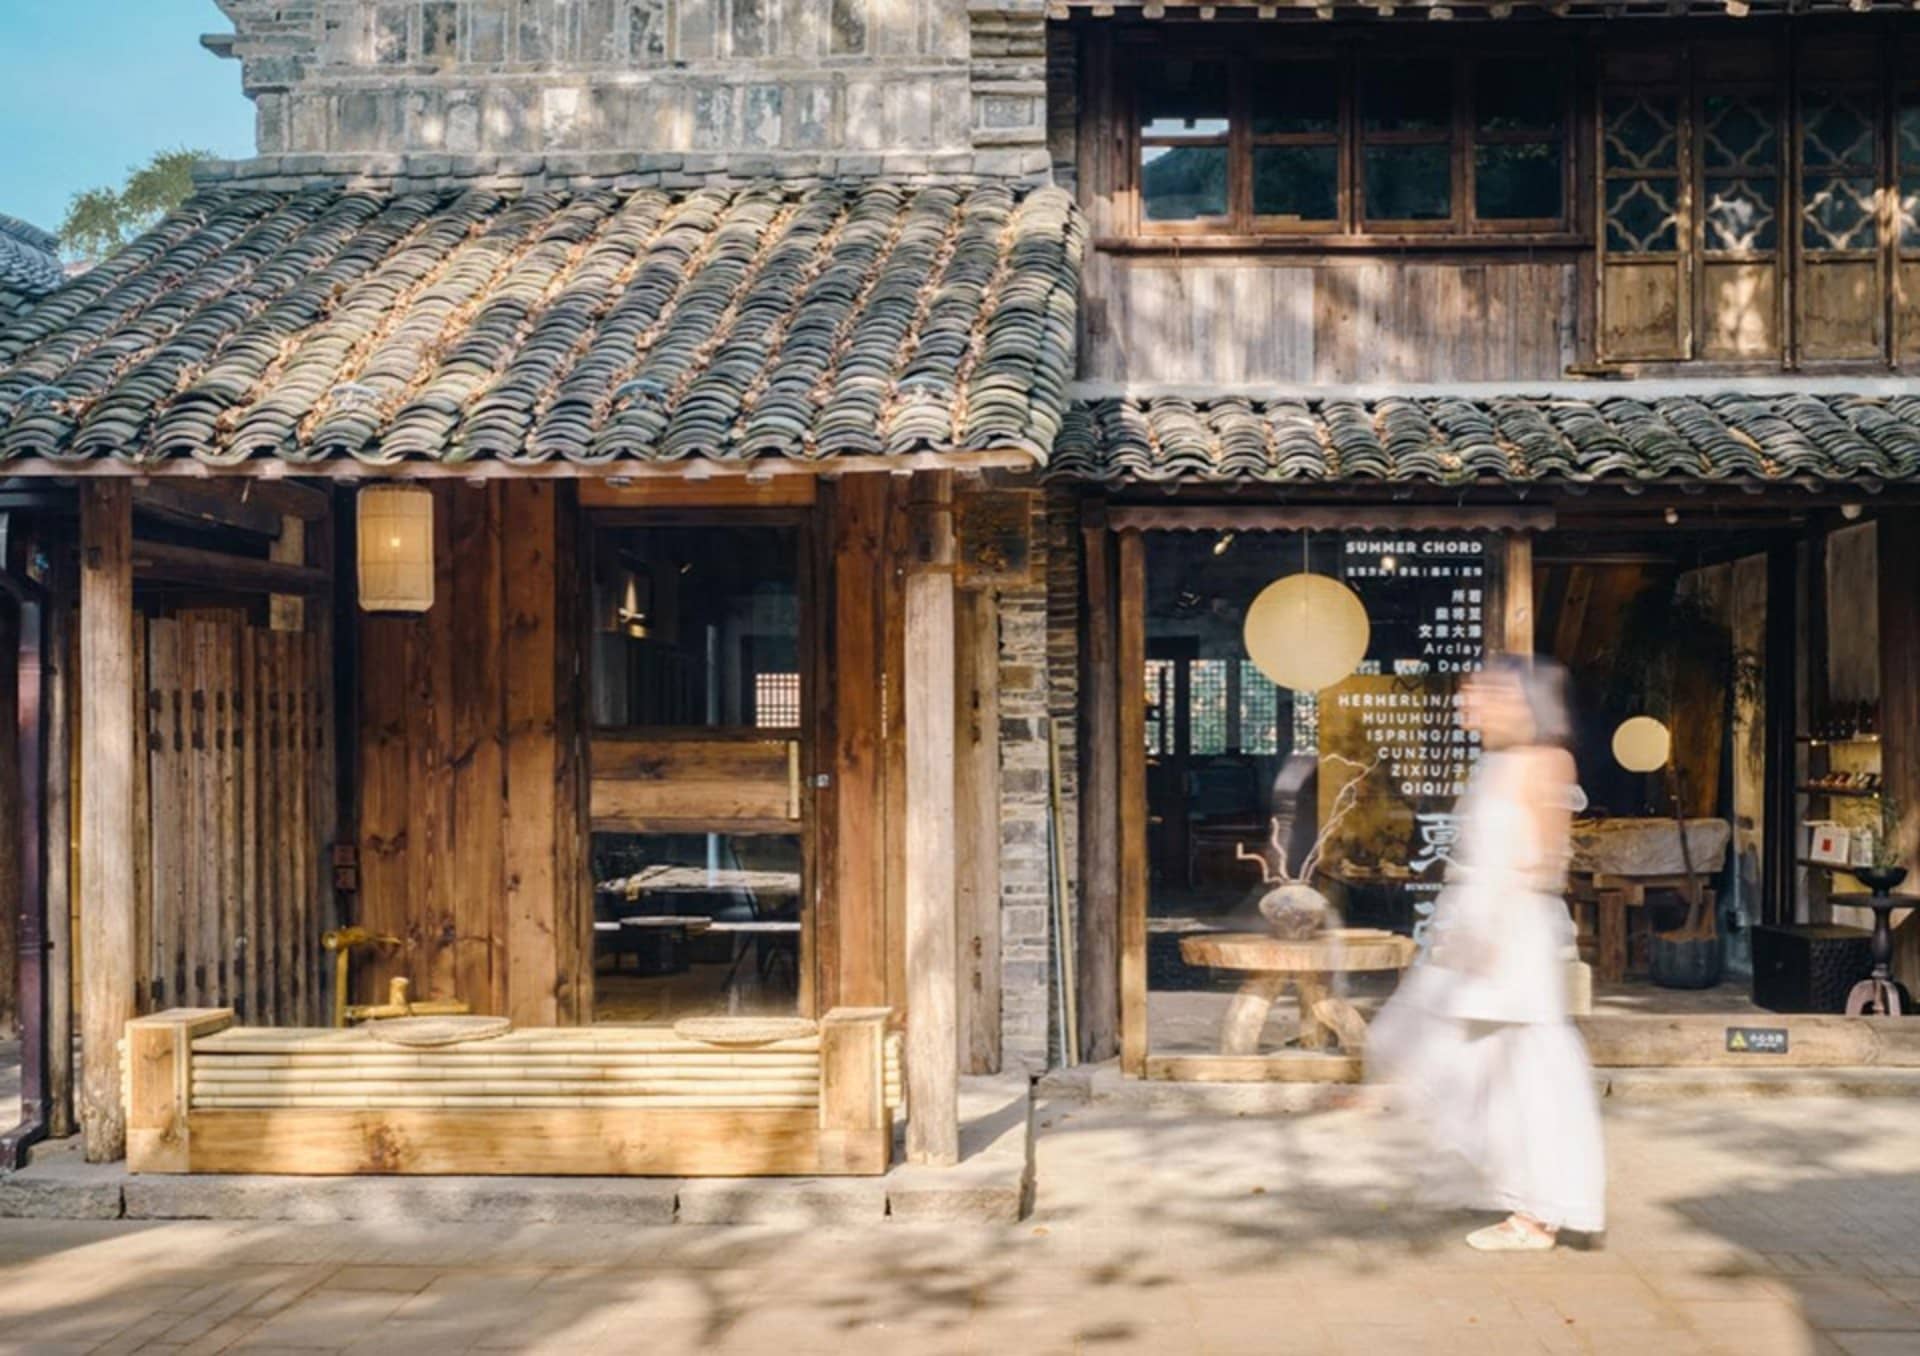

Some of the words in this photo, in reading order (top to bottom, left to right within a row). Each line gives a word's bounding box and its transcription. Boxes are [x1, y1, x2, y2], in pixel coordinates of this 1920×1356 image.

[1346, 541, 1417, 554] SUMMER
[1422, 541, 1482, 554] CHORD
[1423, 642, 1482, 657] Arclay
